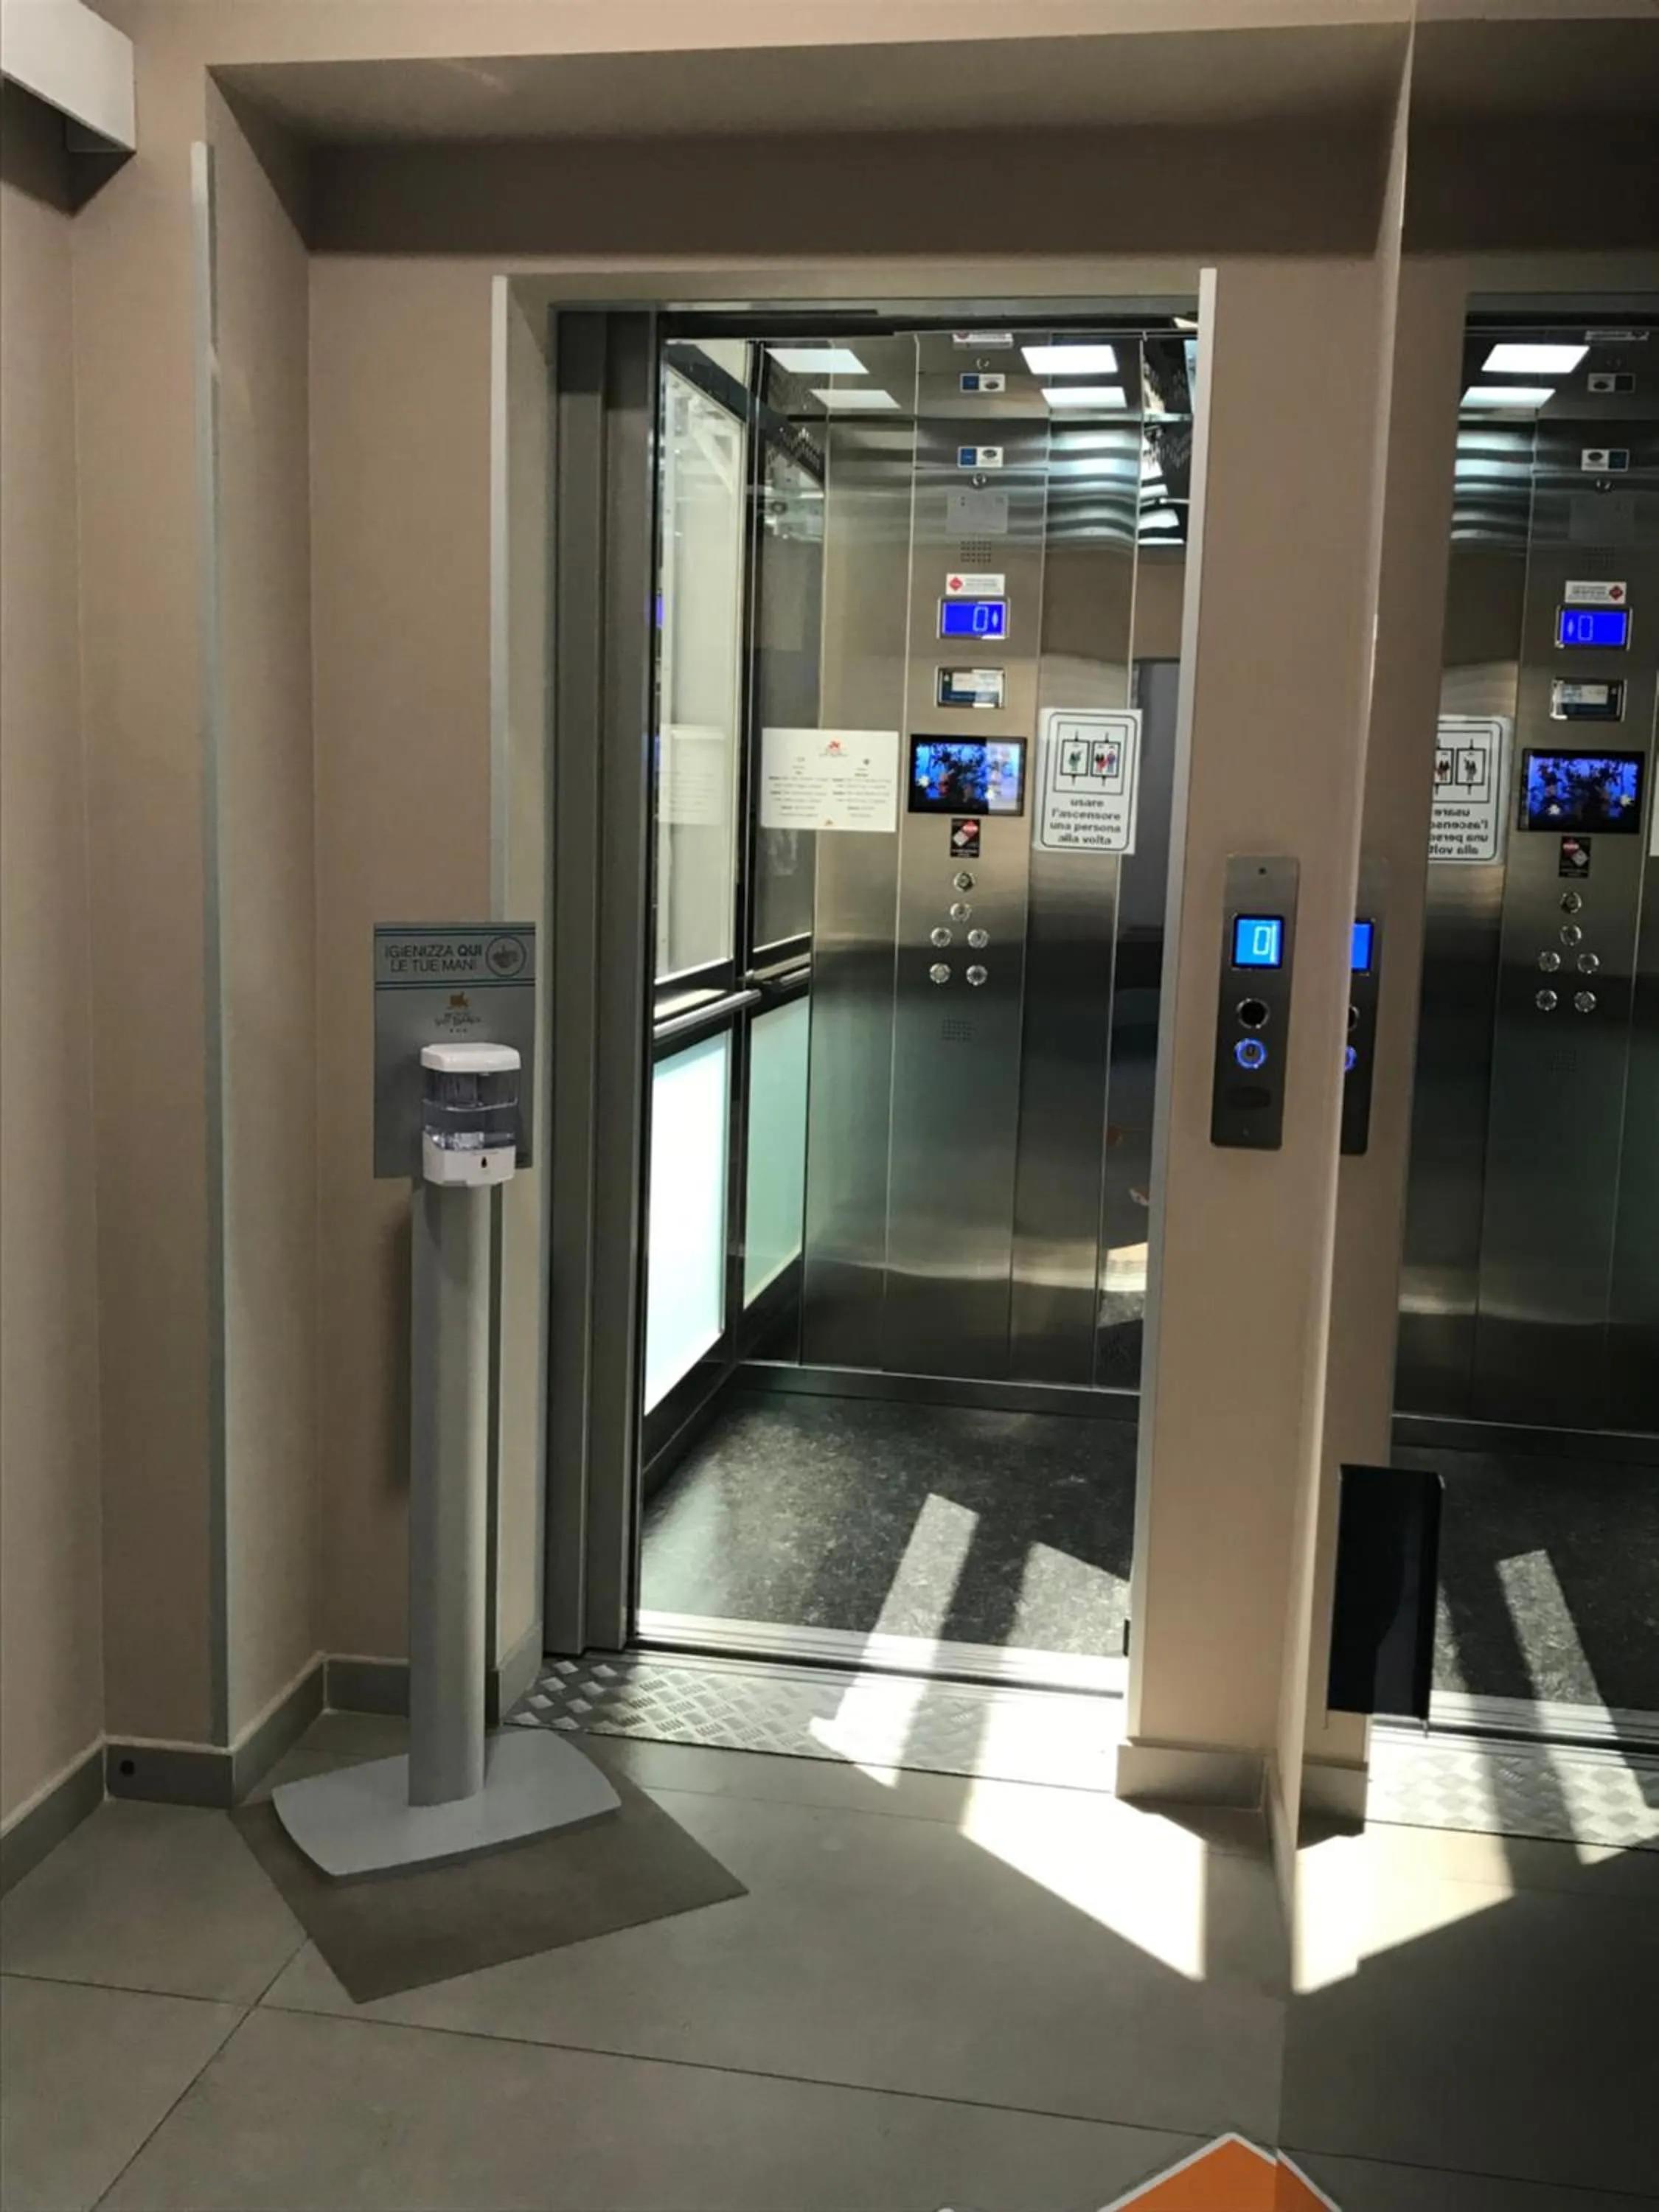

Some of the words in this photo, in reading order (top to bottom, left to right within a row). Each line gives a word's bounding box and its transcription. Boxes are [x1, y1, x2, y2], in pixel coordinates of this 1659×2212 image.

[1070, 799, 1105, 807] usare
[1051, 808, 1121, 821] l'ascensore
[1074, 822, 1121, 833] persona
[1057, 832, 1079, 842] alla
[1082, 834, 1112, 845] volta
[384, 944, 454, 959] IGIENIZZA
[457, 944, 483, 957] QUI
[390, 961, 408, 973] LE
[412, 959, 439, 973] TUE
[442, 959, 477, 971] MANI
